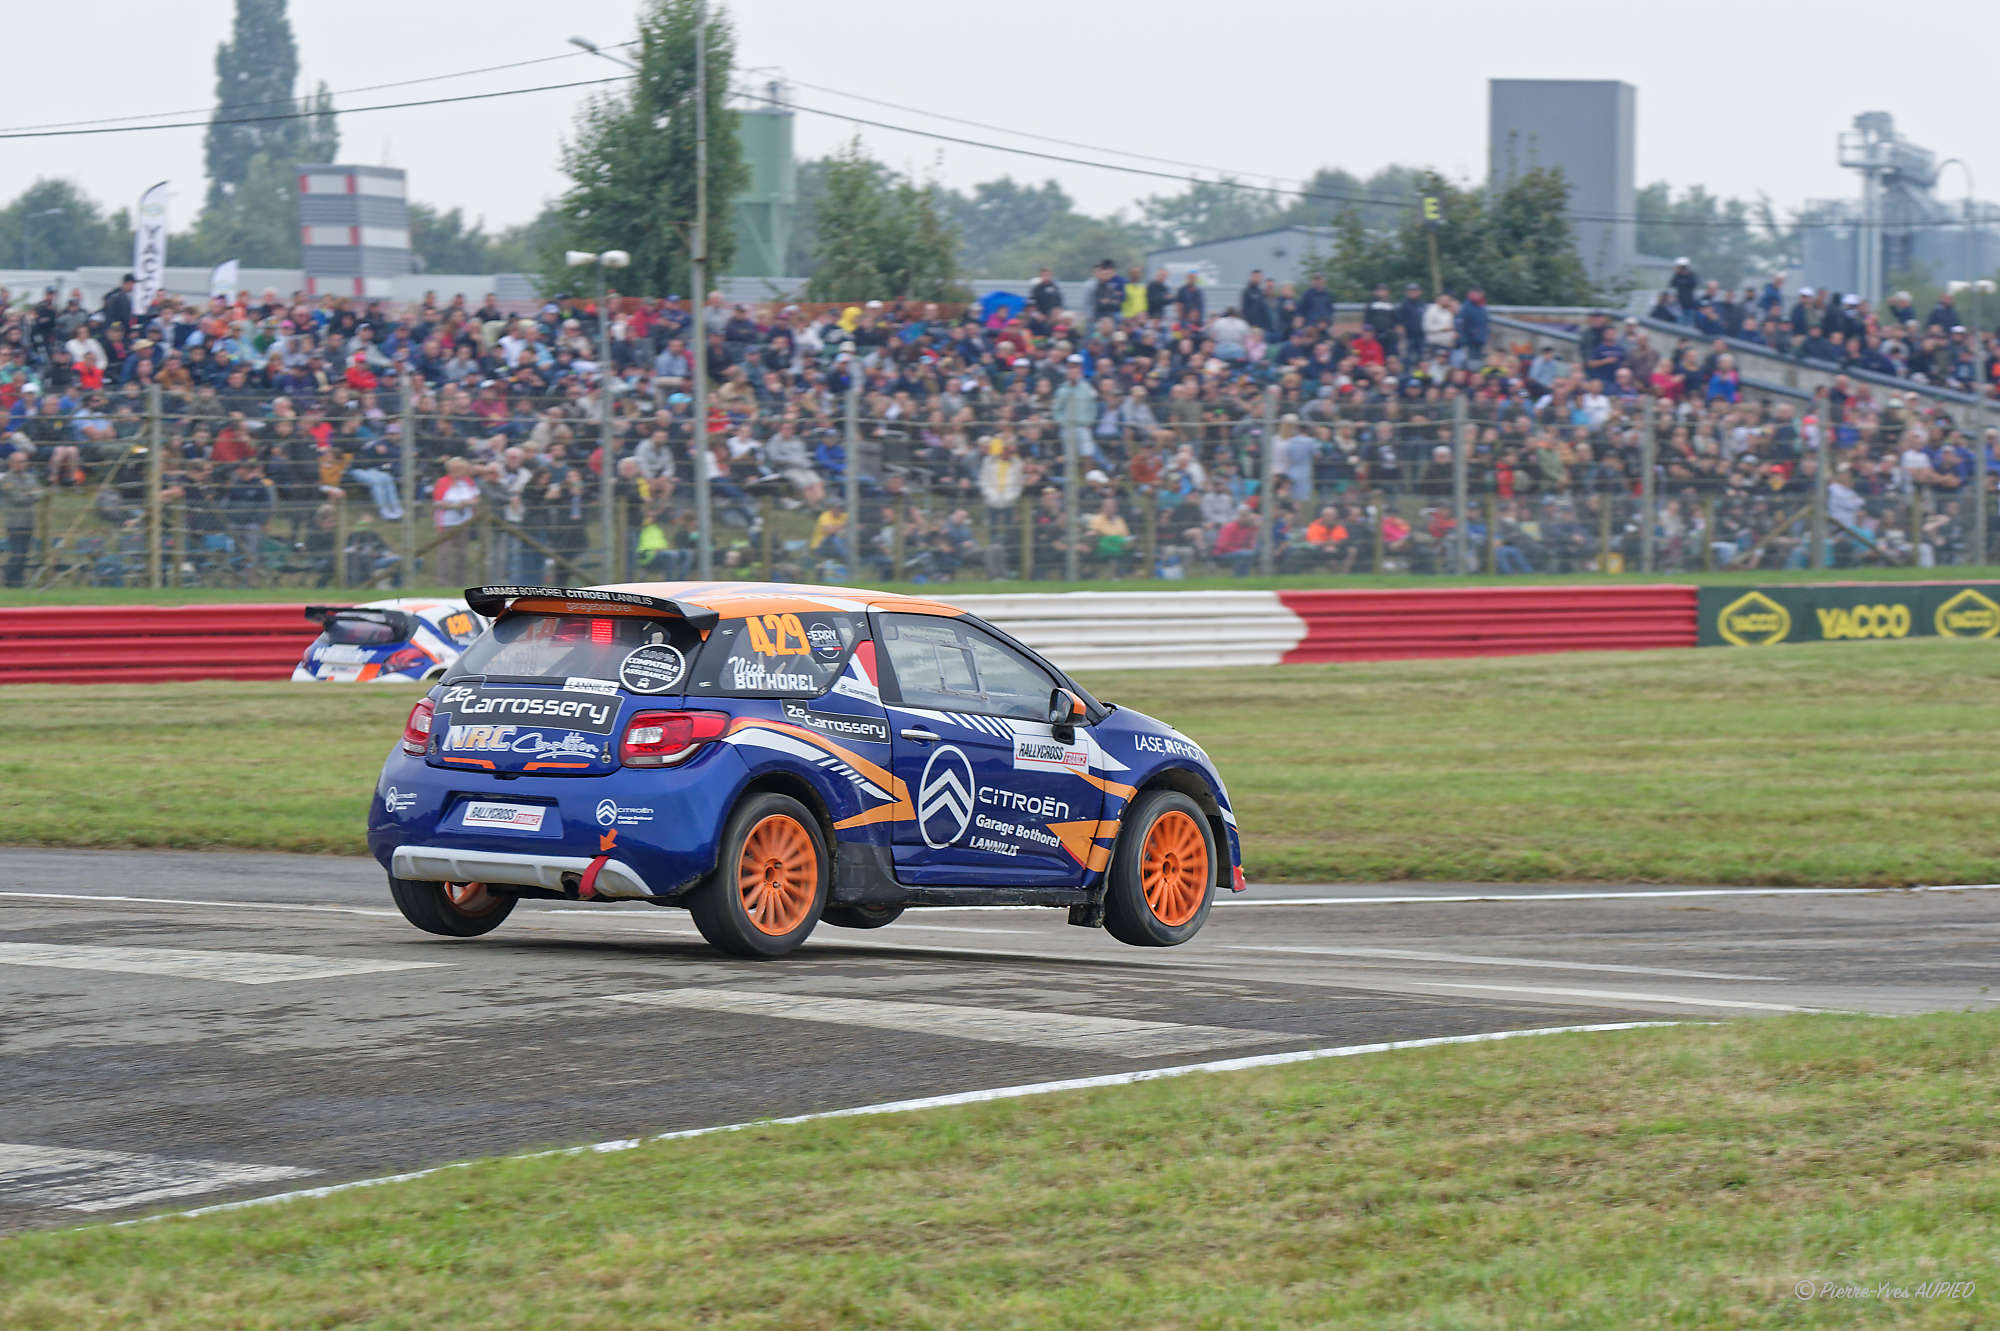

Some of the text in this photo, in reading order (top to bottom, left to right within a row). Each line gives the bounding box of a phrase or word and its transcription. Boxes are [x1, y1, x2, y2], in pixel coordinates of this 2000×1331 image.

[1423, 196, 1440, 219] E
[482, 587, 519, 596] GARAGE
[519, 588, 565, 598] BOTHOREL
[565, 590, 610, 600] CITROEN
[1816, 604, 1911, 639] YACCO
[745, 613, 811, 657] 429
[623, 668, 676, 682] ASSURANCES
[626, 657, 680, 673] COMPATIBLE
[728, 656, 766, 674] Nico
[733, 673, 818, 691] BOTHOREL
[442, 685, 610, 725] Ze Carrossery
[786, 704, 886, 739] Ze Carrossery
[442, 726, 517, 752] NRC
[1019, 743, 1065, 761] RALLYCROSS
[470, 806, 518, 820] RALLYCROSS
[978, 786, 1070, 819] CITROËN
[976, 814, 1061, 848] Garage Bothorel
[969, 836, 1020, 857] LANNILIS
